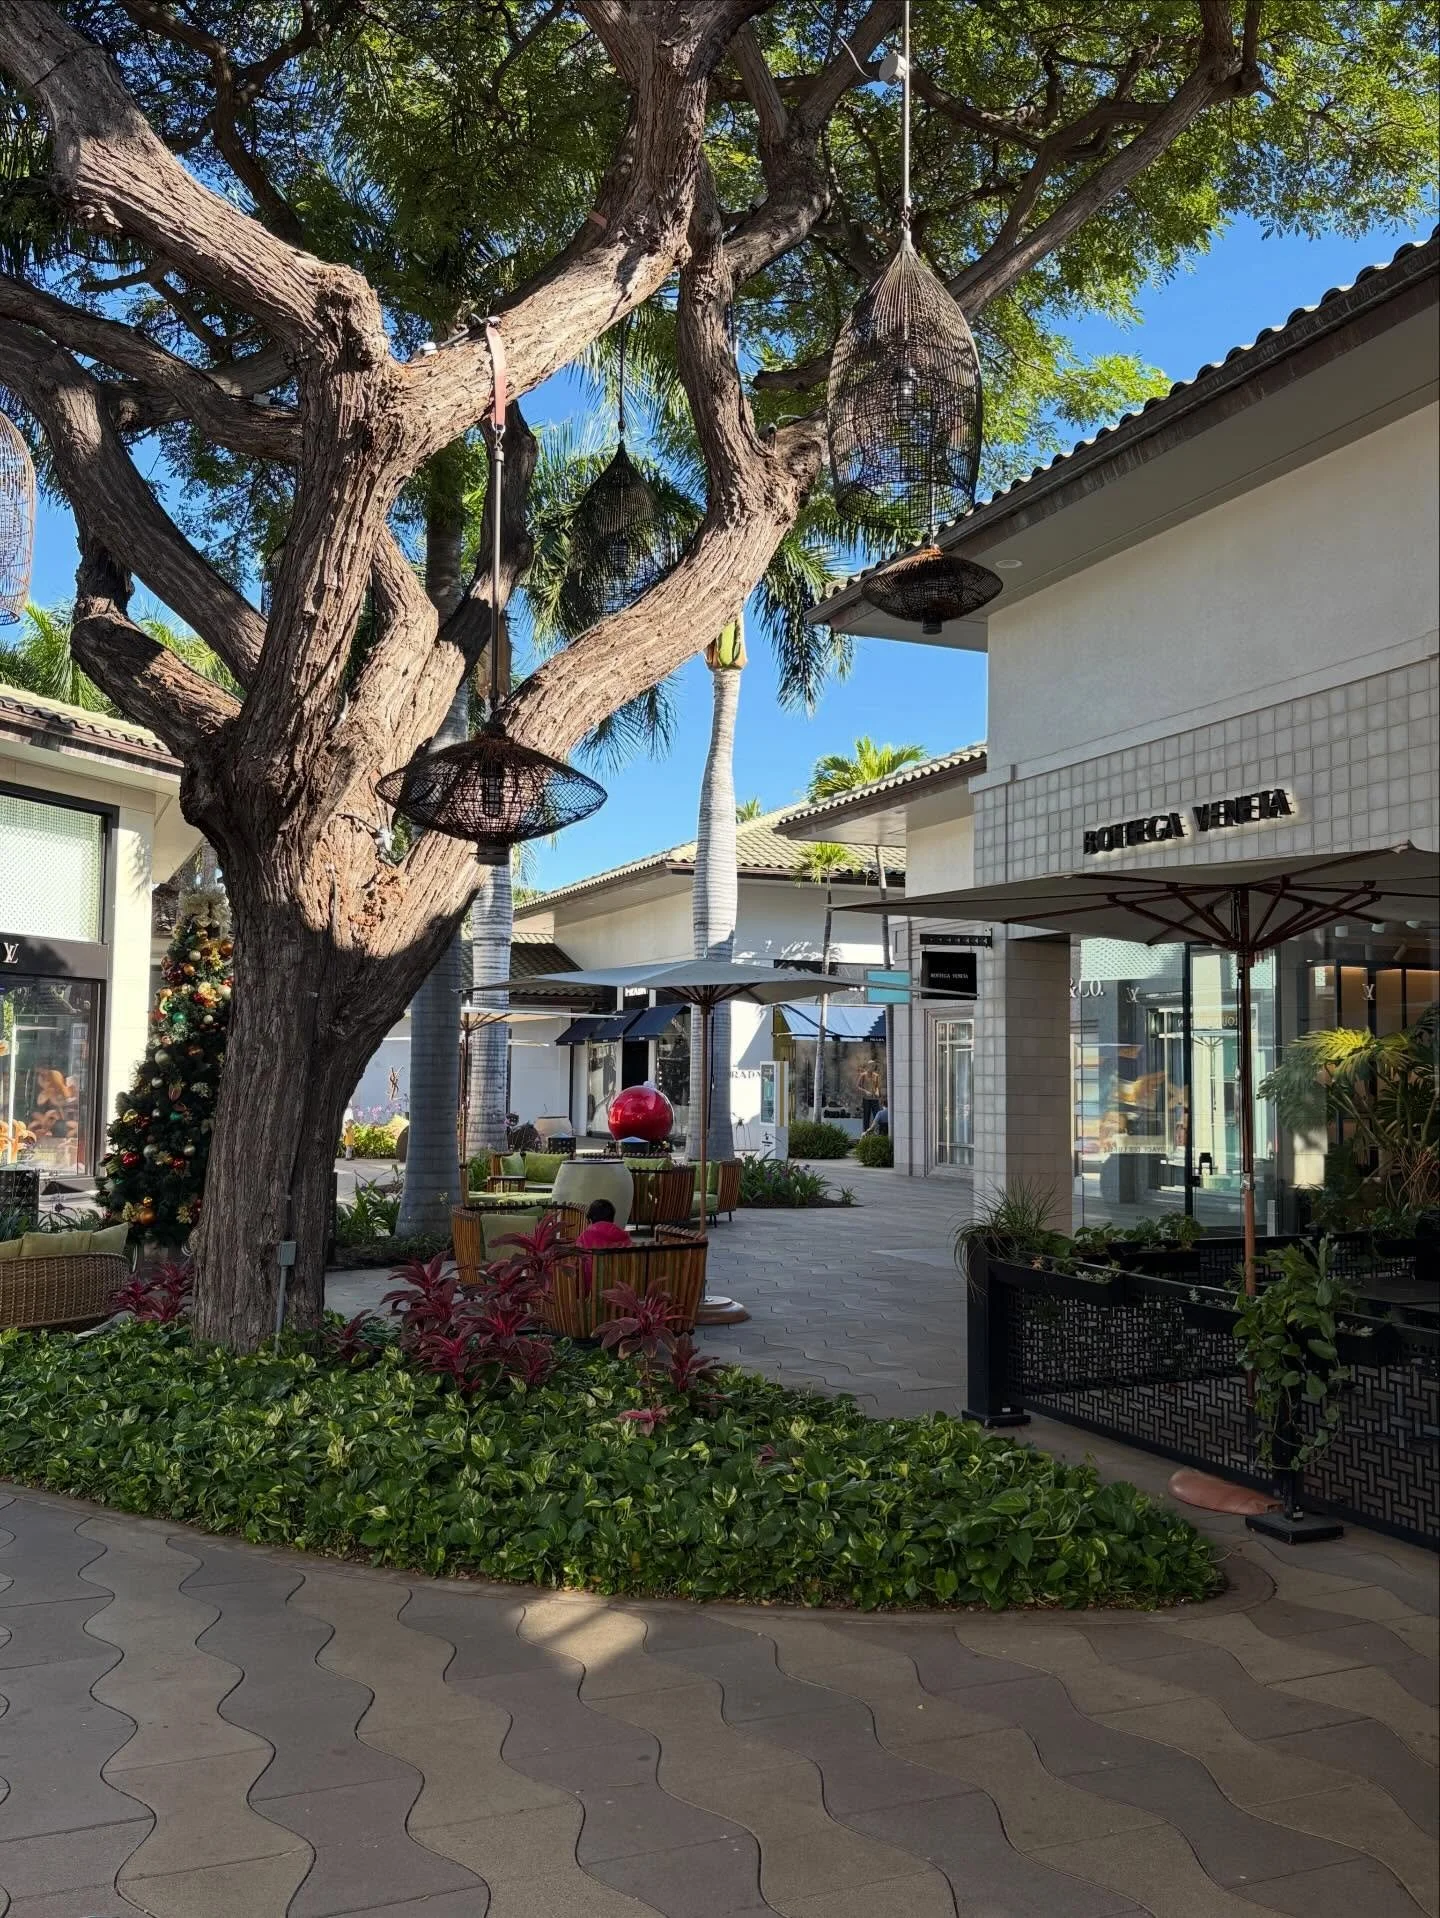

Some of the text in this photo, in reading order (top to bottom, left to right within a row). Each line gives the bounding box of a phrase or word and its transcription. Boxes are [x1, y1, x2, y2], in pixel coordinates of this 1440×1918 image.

[1083, 788, 1292, 855] BOTTEGA VENETA
[730, 1070, 761, 1080] RADA
